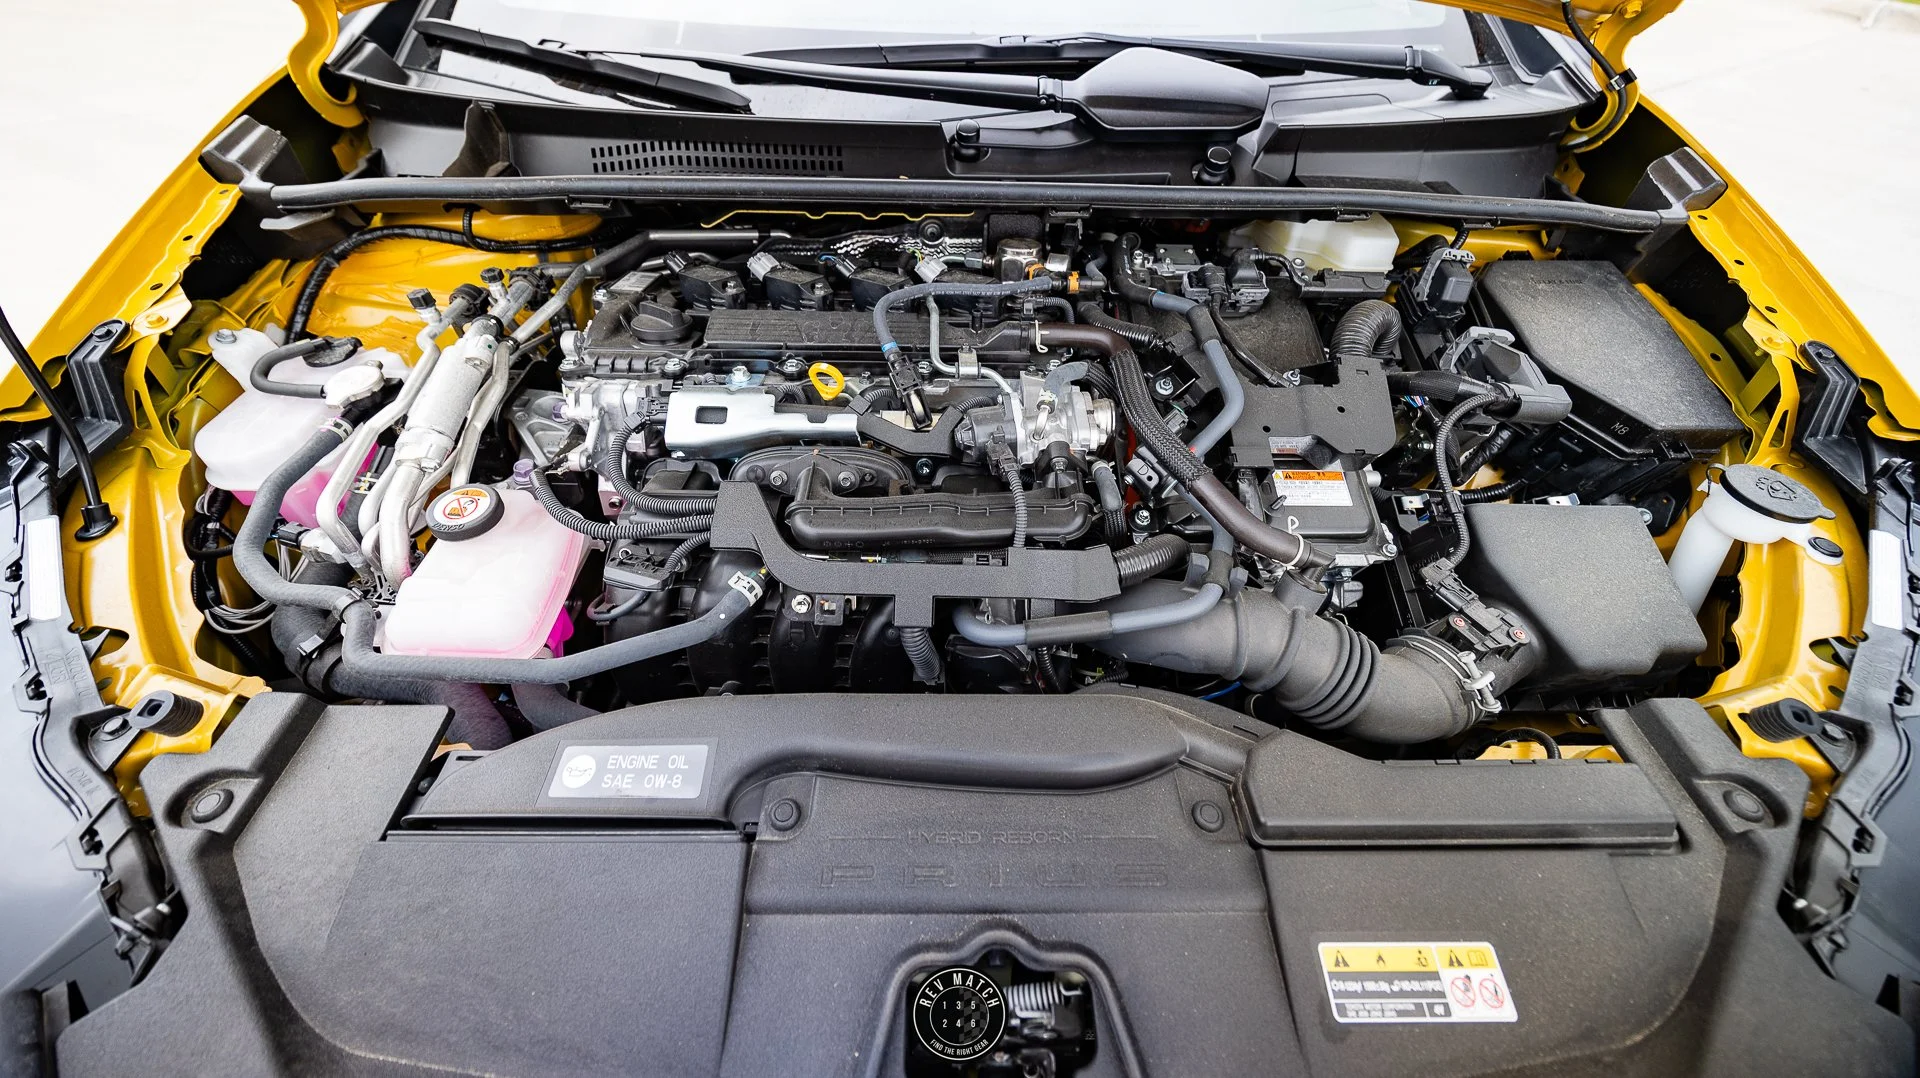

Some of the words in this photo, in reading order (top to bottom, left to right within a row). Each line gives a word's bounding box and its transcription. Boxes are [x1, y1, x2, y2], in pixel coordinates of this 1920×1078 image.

[1610, 422, 1630, 435] M8
[606, 755, 660, 769] ENGINE
[667, 755, 689, 769] OIL
[601, 774, 635, 788] SAE
[908, 831, 982, 845] HYBRID
[992, 831, 1077, 845] REBORN
[819, 863, 1169, 888] PRIUS
